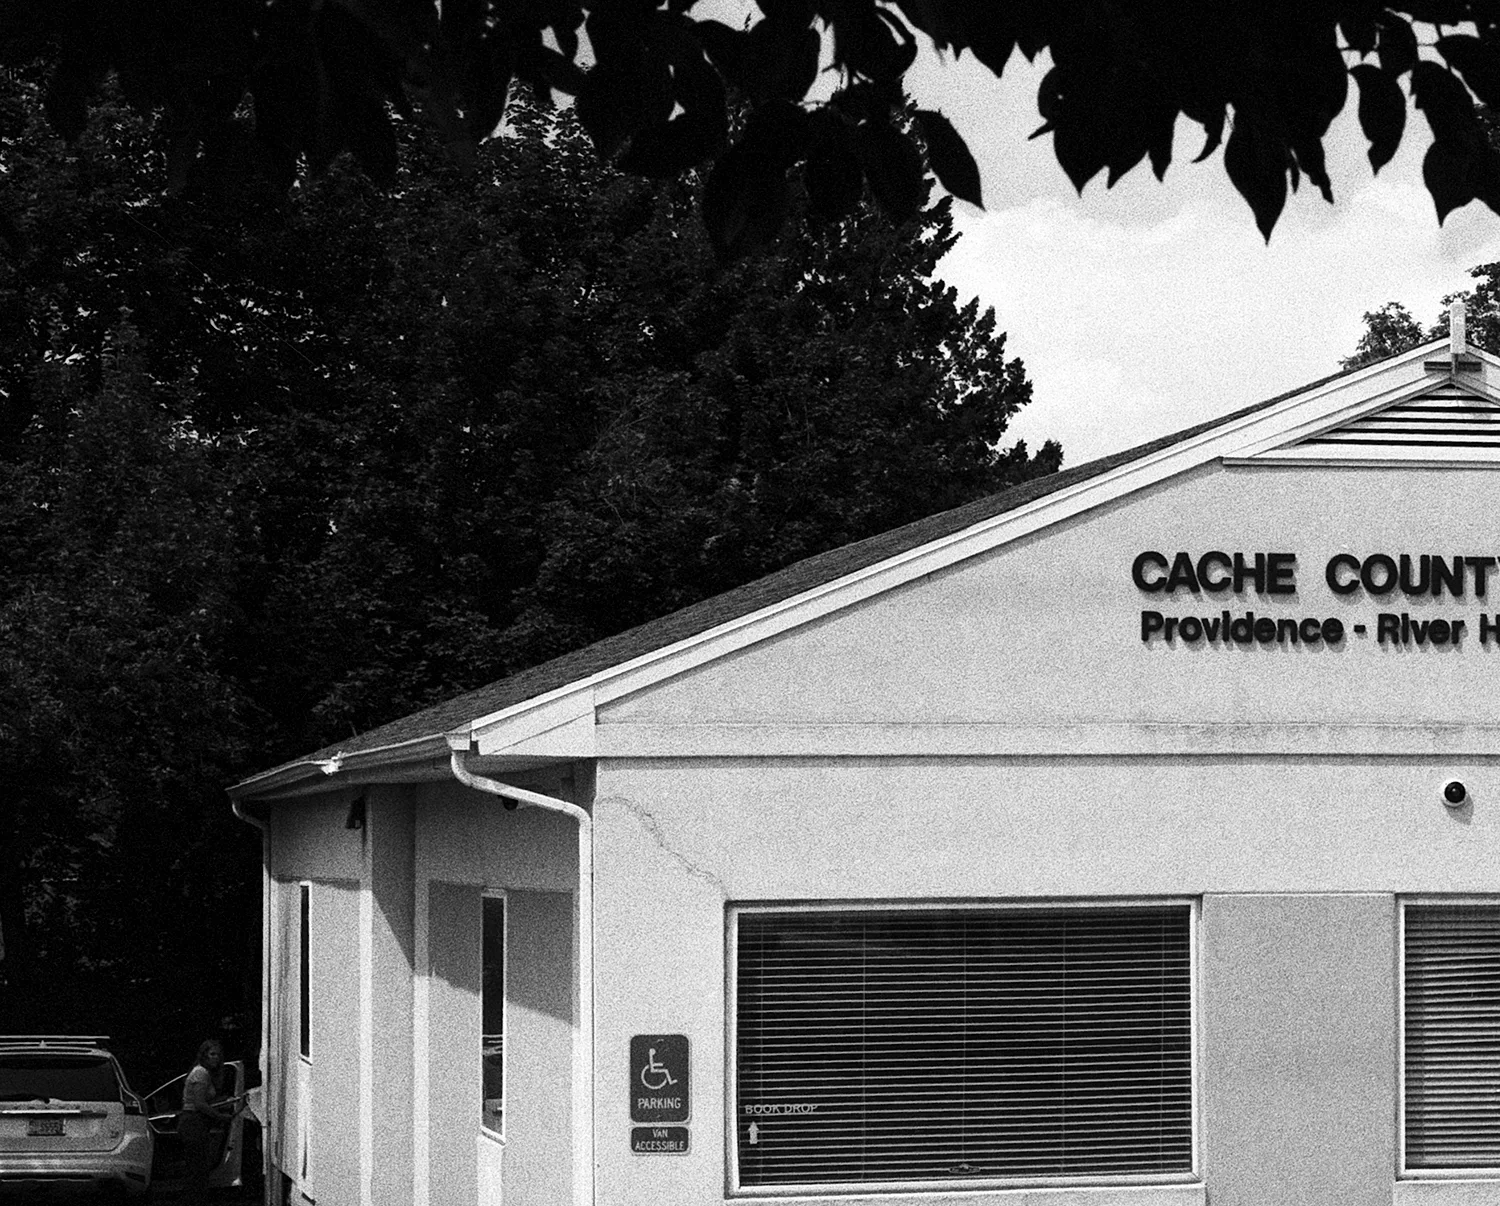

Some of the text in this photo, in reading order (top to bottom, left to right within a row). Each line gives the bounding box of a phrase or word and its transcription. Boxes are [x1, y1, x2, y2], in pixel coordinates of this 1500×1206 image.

[1132, 551, 1296, 595] CACHE
[1141, 611, 1344, 645] Providence
[1377, 612, 1465, 645] River
[637, 1097, 682, 1110] PARKING
[745, 1103, 818, 1115] BOOK DROP
[652, 1128, 669, 1139] VAN
[635, 1140, 685, 1152] ACCESSIBLE
